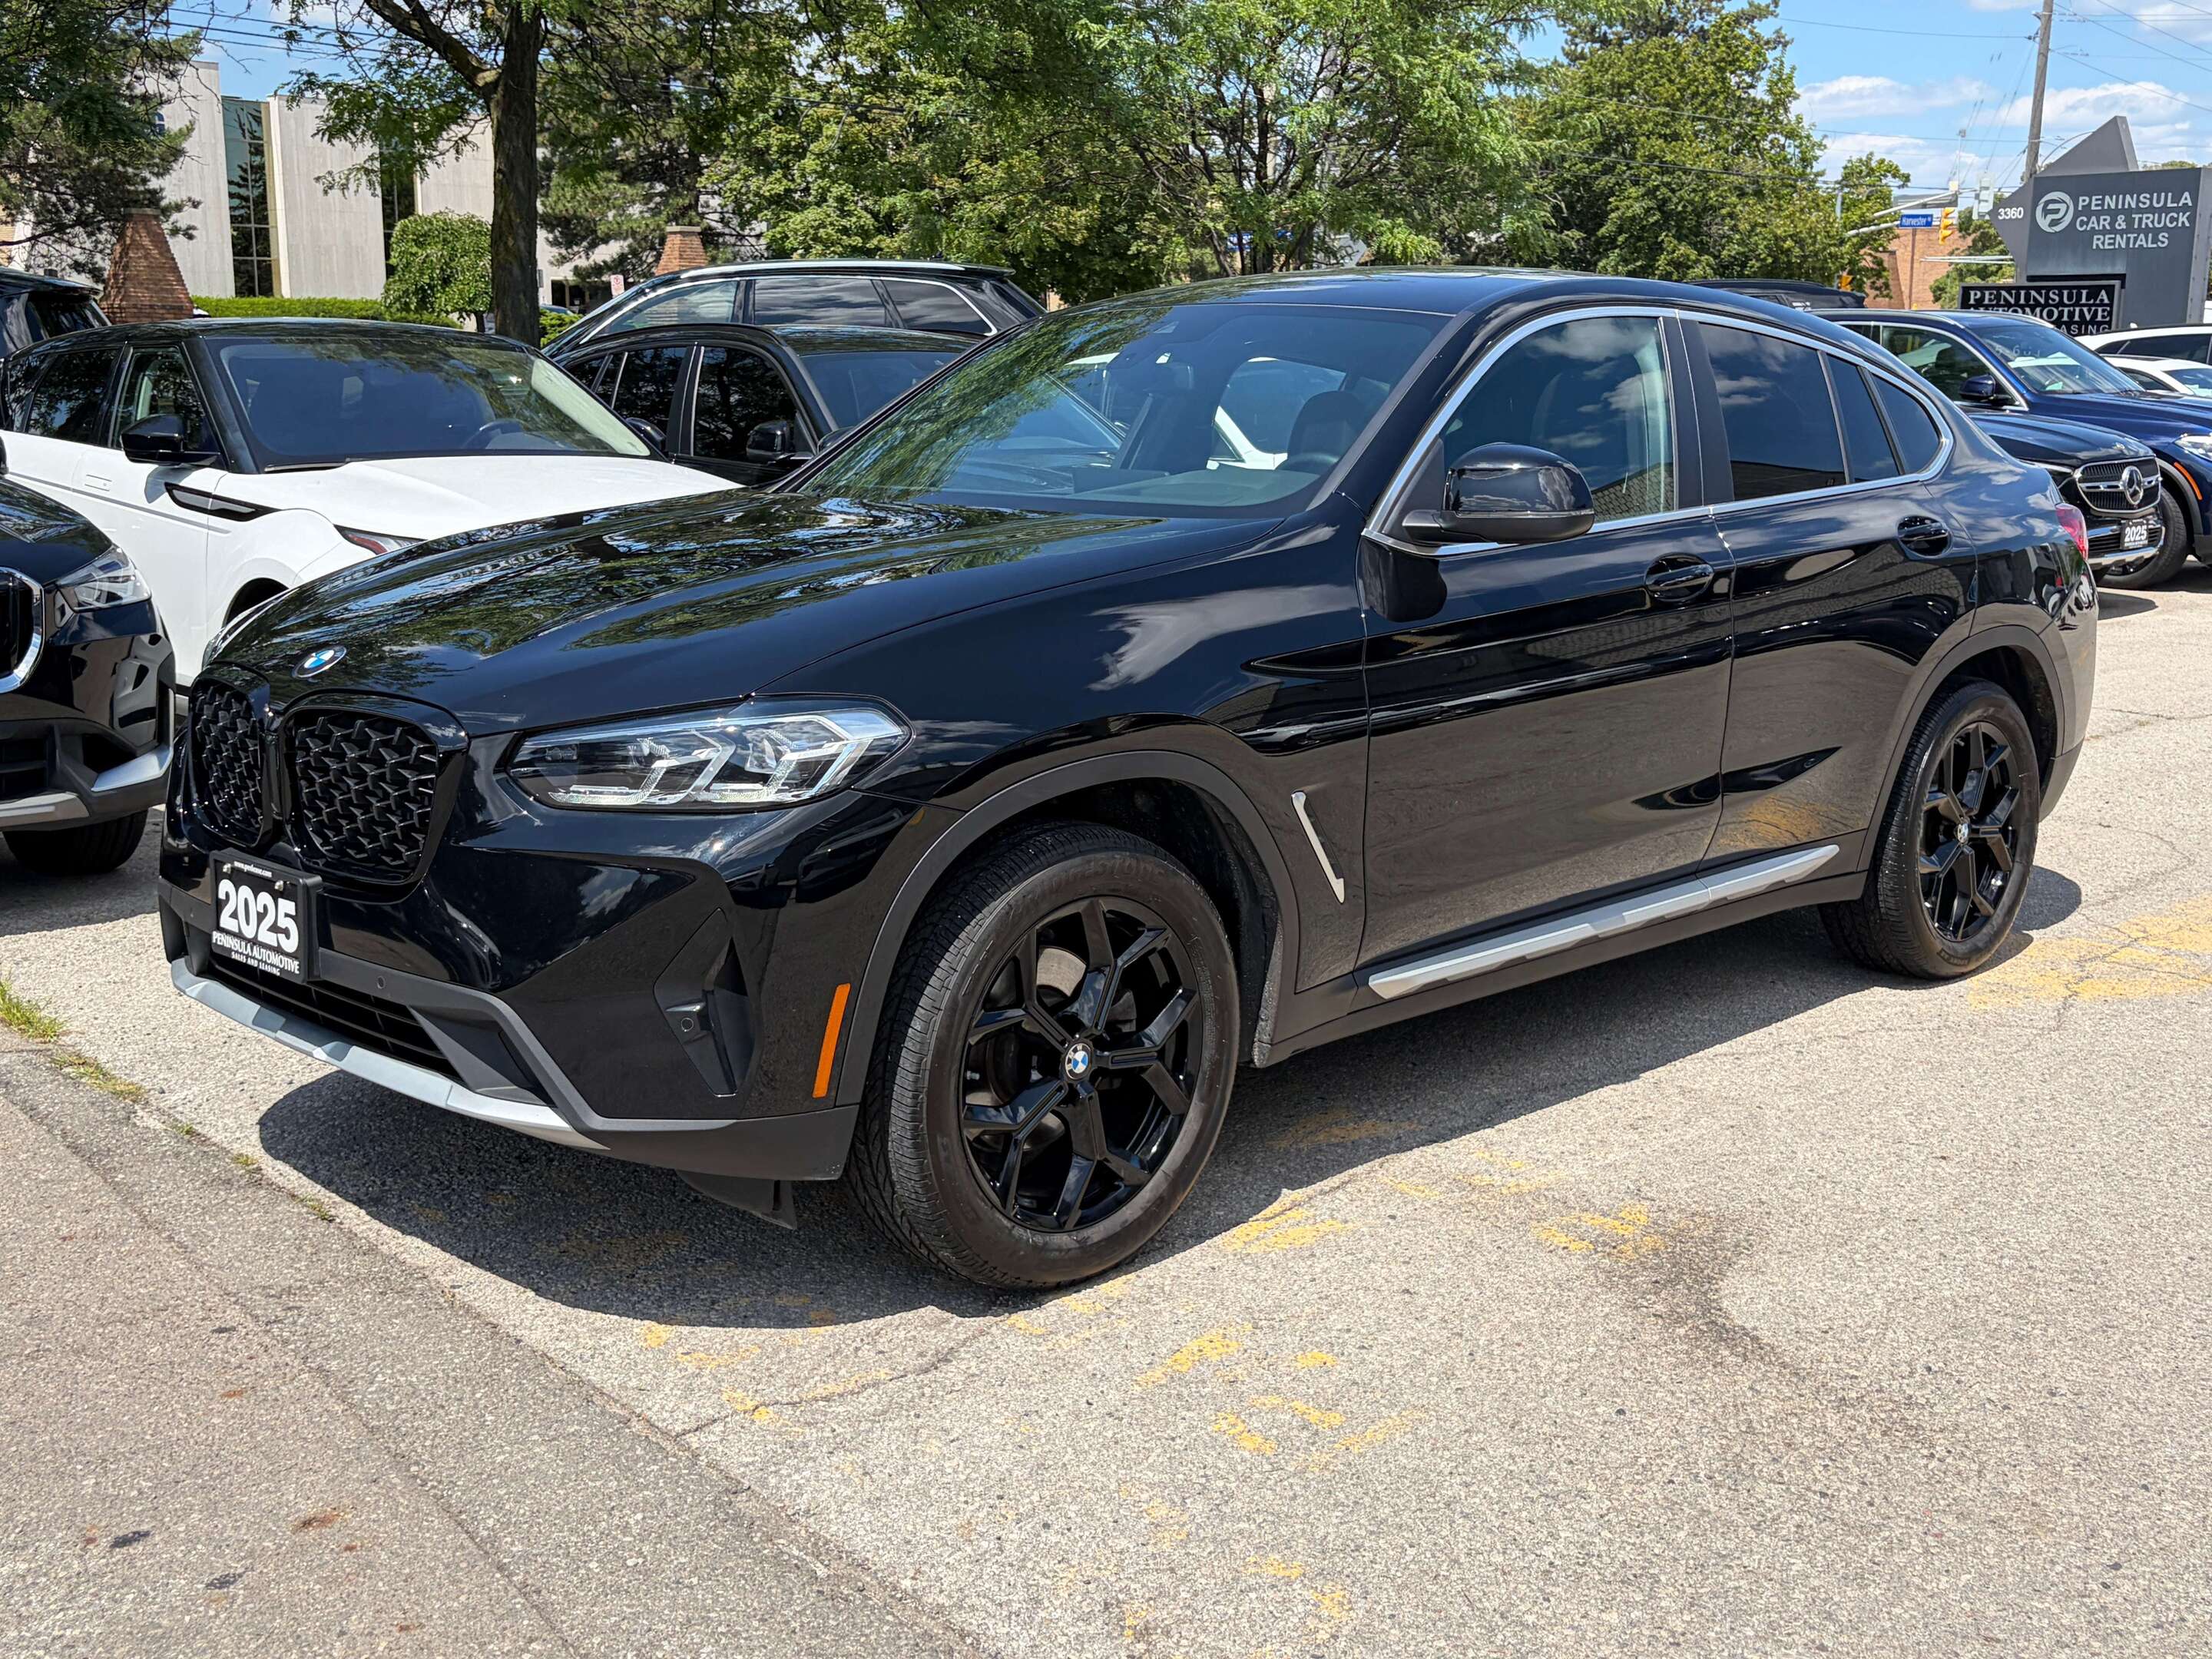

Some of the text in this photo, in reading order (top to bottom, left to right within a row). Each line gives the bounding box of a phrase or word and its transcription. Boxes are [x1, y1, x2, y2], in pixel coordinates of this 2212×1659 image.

[2078, 192, 2193, 210] PENINSULA
[1998, 207, 2024, 220] 3360
[2075, 211, 2191, 230] CAR & TRUCK
[2092, 233, 2169, 250] RENTALS
[1969, 289, 2111, 305] PENINSULA
[2059, 324, 2109, 335] ASING
[2124, 525, 2147, 542] 2025
[218, 879, 299, 953] 2025
[212, 930, 300, 974] PENINSULA AUTOMOTIVE
[247, 957, 258, 968] AND
